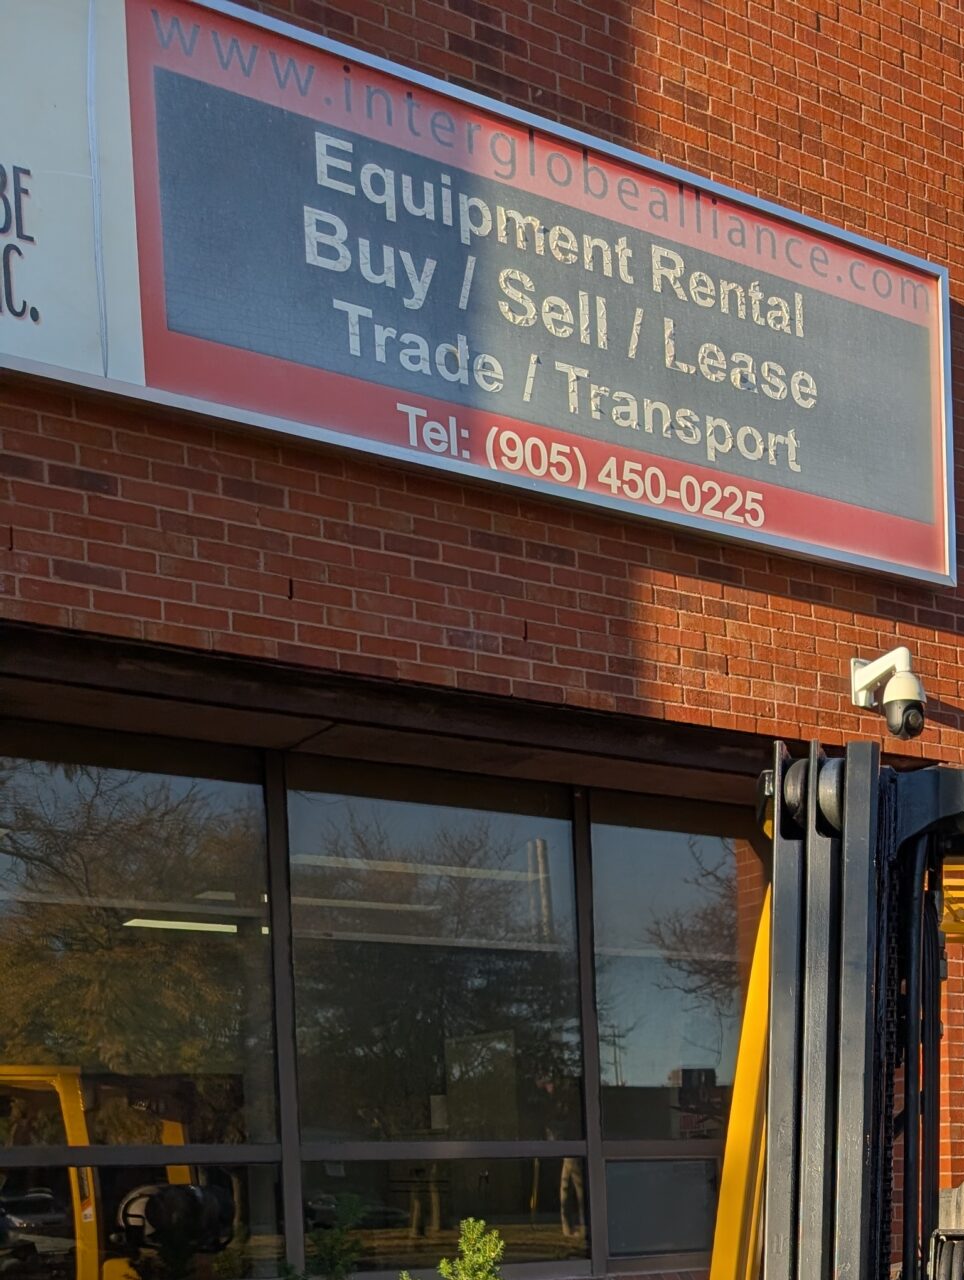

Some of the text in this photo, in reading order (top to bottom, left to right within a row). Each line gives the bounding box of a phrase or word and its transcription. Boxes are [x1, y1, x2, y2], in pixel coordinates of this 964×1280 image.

[151, 8, 931, 314] www.interglobealliance.com
[314, 131, 806, 338] Equipment Rental
[302, 205, 818, 409] Buy / Sell / Lease
[332, 298, 802, 473] Trade / Transport
[396, 402, 766, 528] Tel: (905) 450-0225
